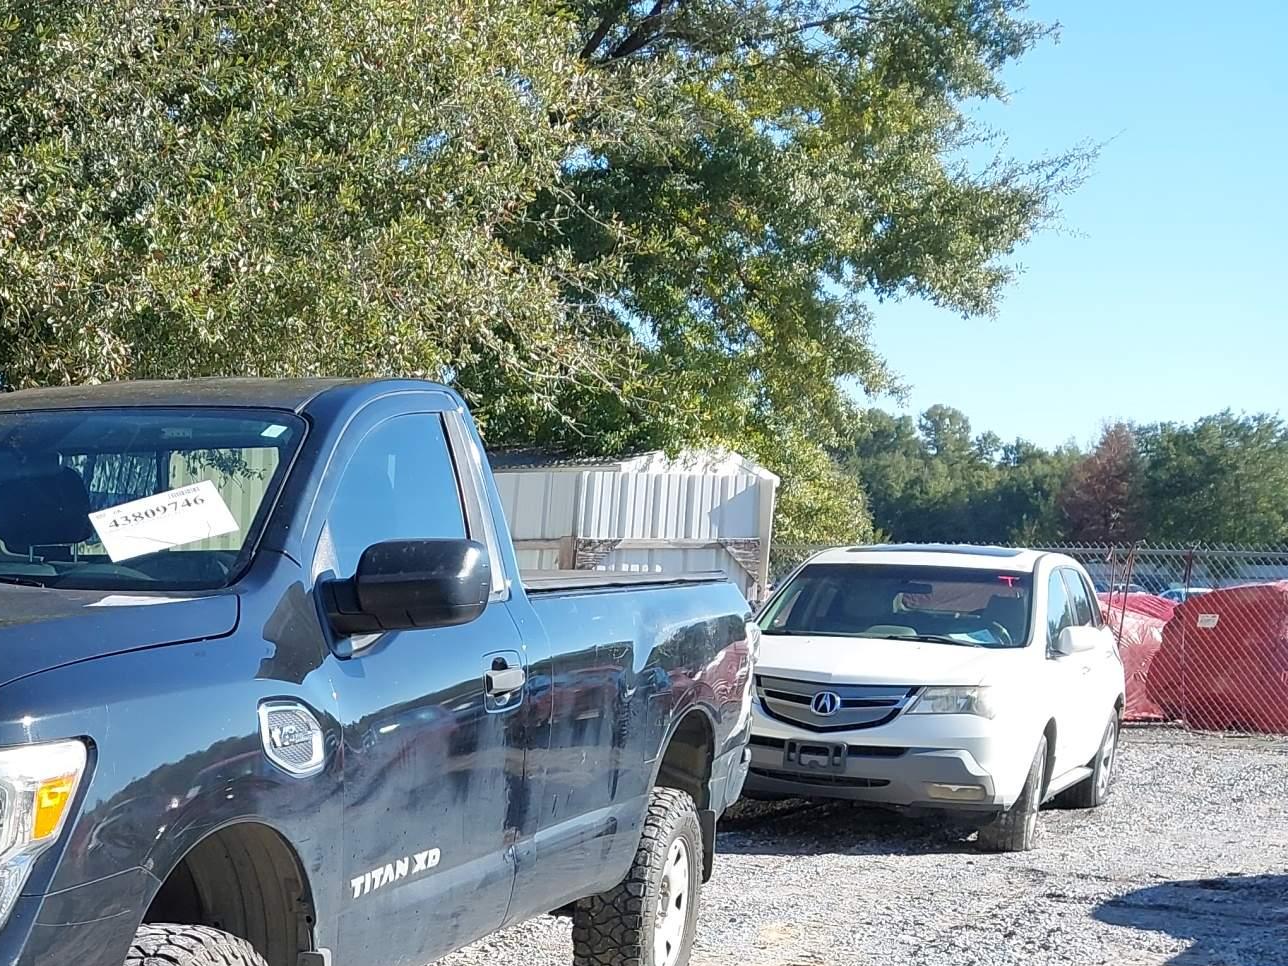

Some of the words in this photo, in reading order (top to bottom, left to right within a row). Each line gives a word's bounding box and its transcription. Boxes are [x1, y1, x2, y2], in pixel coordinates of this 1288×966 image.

[108, 495, 206, 529] 43809746
[350, 857, 409, 899] TITAN
[412, 847, 441, 874] XD
